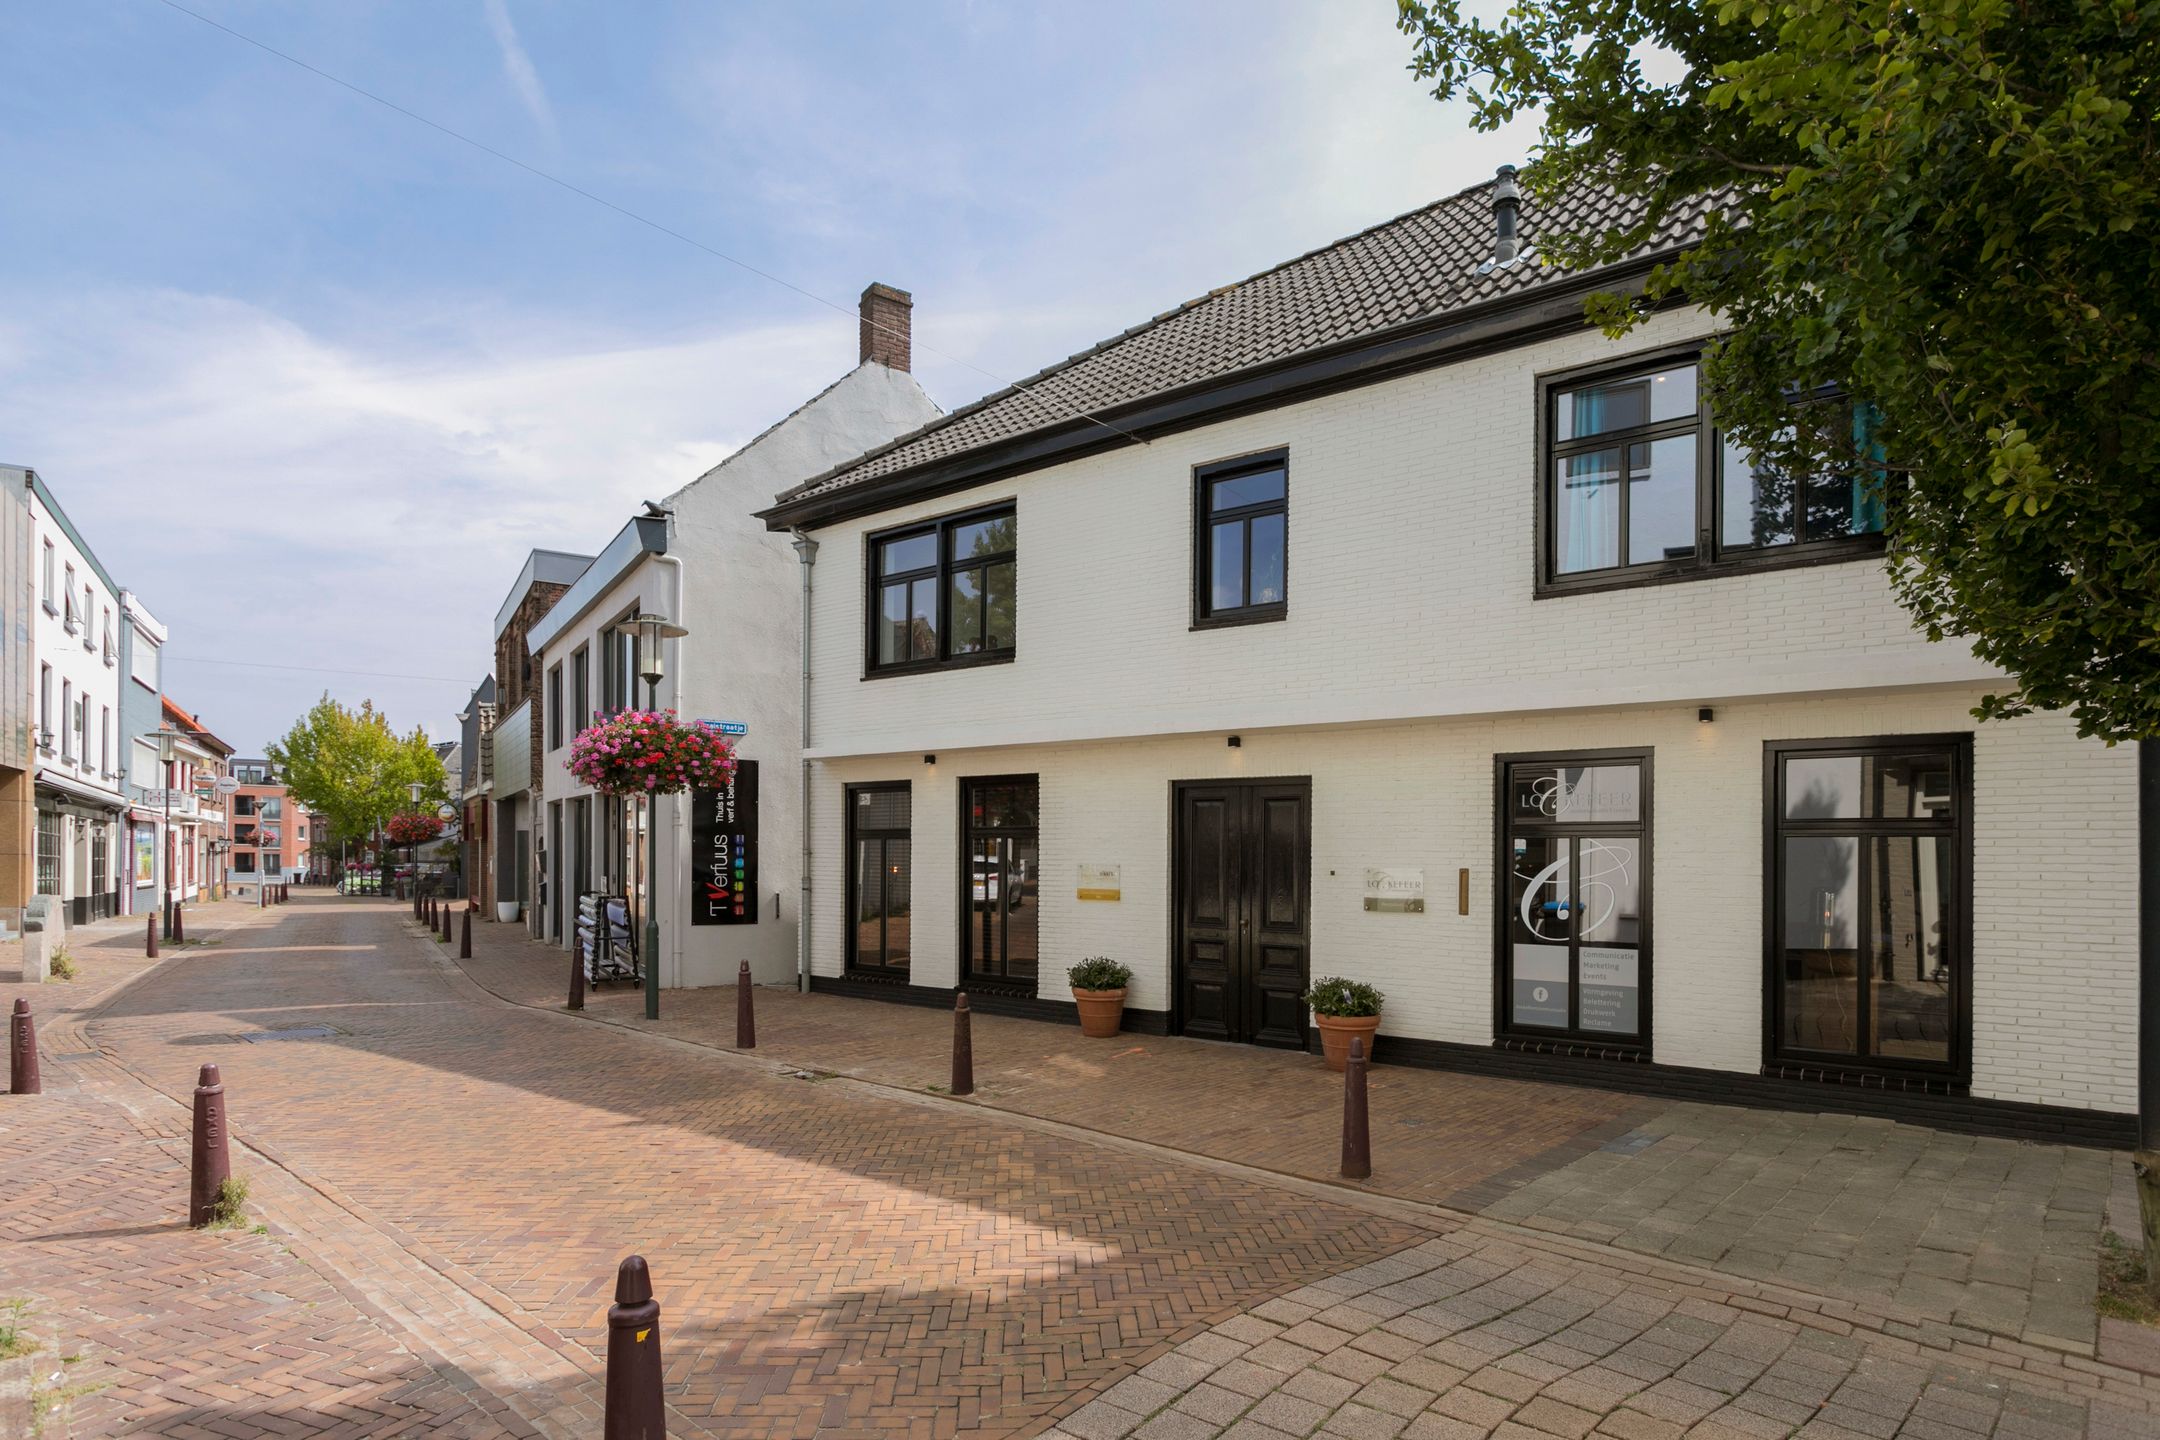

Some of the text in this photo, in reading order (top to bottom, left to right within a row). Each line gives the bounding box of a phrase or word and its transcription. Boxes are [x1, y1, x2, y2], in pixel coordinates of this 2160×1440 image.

[716, 792, 724, 823] Thuis in
[726, 808, 735, 823] verf
[1582, 951, 1635, 961] Communicatie
[1583, 962, 1620, 971] Marketing
[1583, 972, 1607, 981] Events
[1583, 1007, 1616, 1017] Drukwerk
